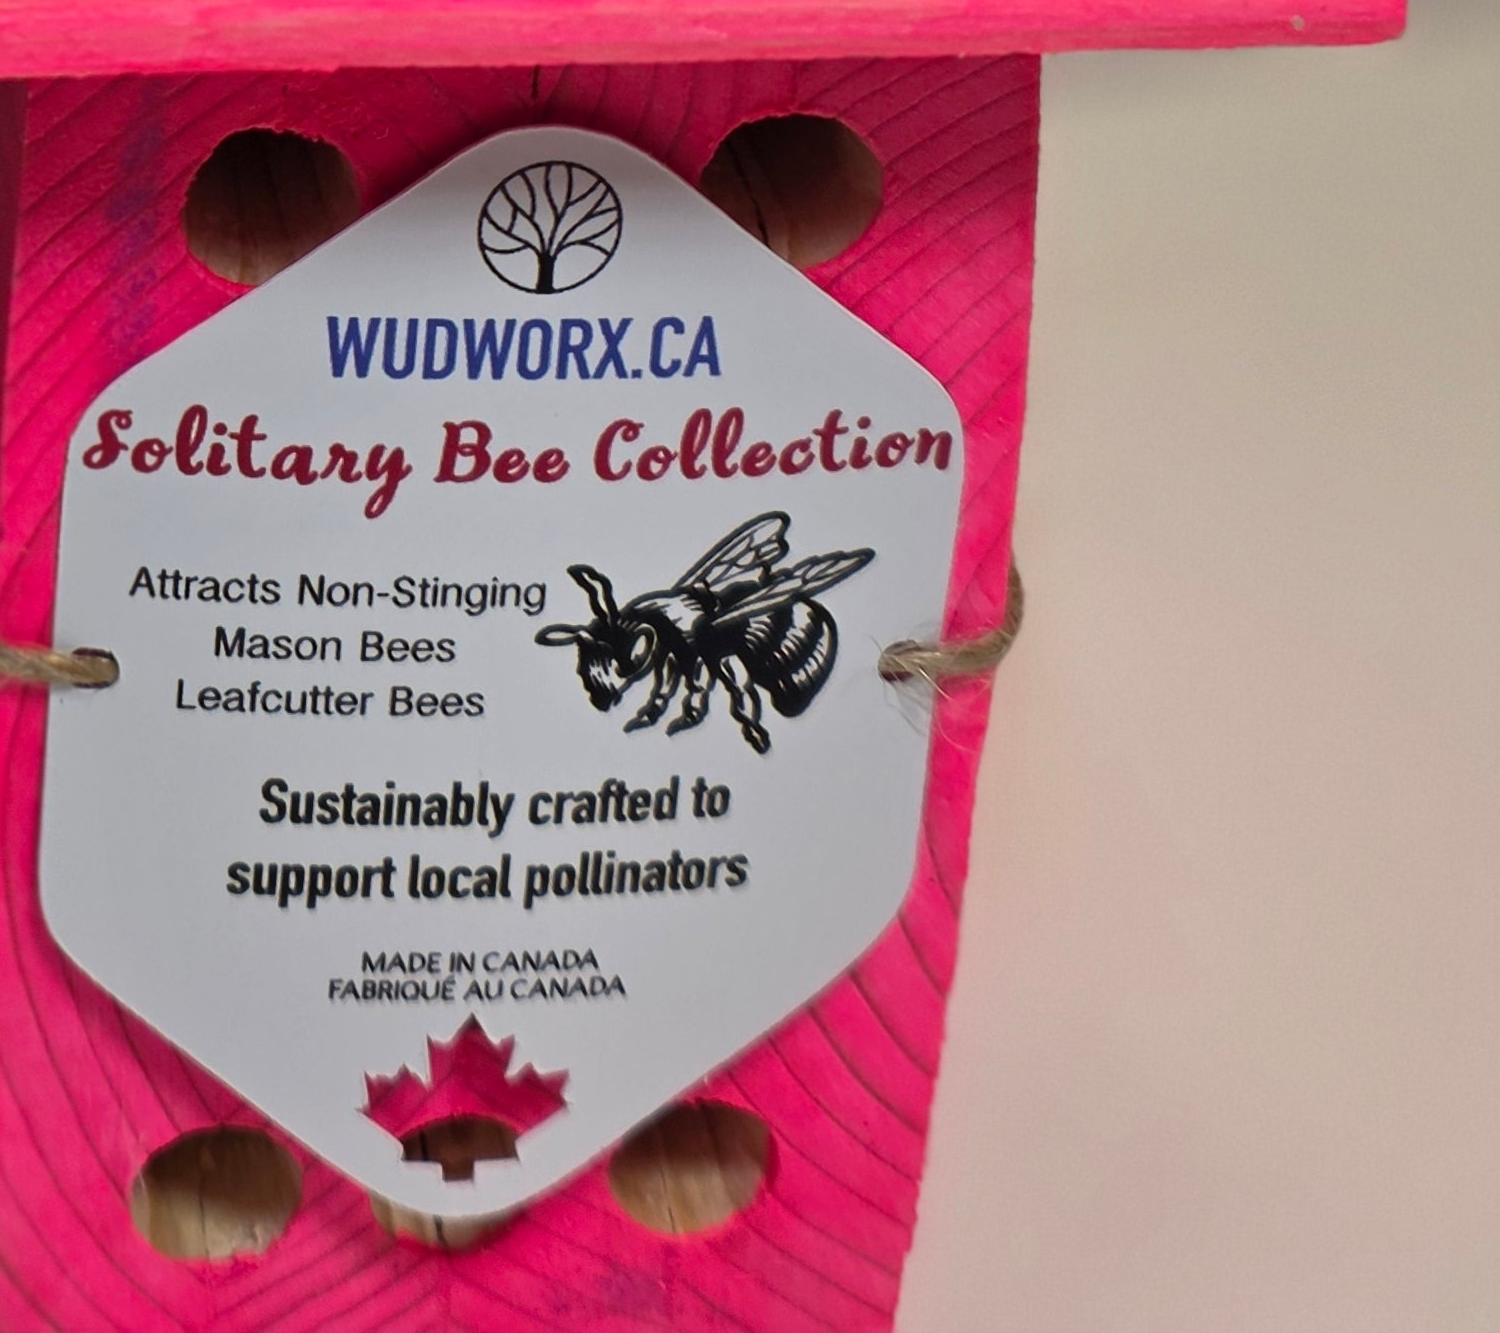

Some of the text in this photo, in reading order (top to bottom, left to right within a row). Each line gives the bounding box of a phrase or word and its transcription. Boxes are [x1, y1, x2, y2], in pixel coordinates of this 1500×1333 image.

[326, 315, 722, 380] WUDWORX.CA
[82, 405, 952, 518] Solitary Bee Collection
[129, 565, 547, 615] Attracts Non-Stinging
[214, 627, 455, 662] Mason Bees
[176, 679, 486, 719] Leafcutter Bees
[259, 776, 731, 837] Sustainably crafted to
[225, 849, 749, 909] support local pollinators
[362, 948, 599, 975] MADE IN CANADA
[328, 973, 626, 1002] FABRIQUÉ AU CANADA
